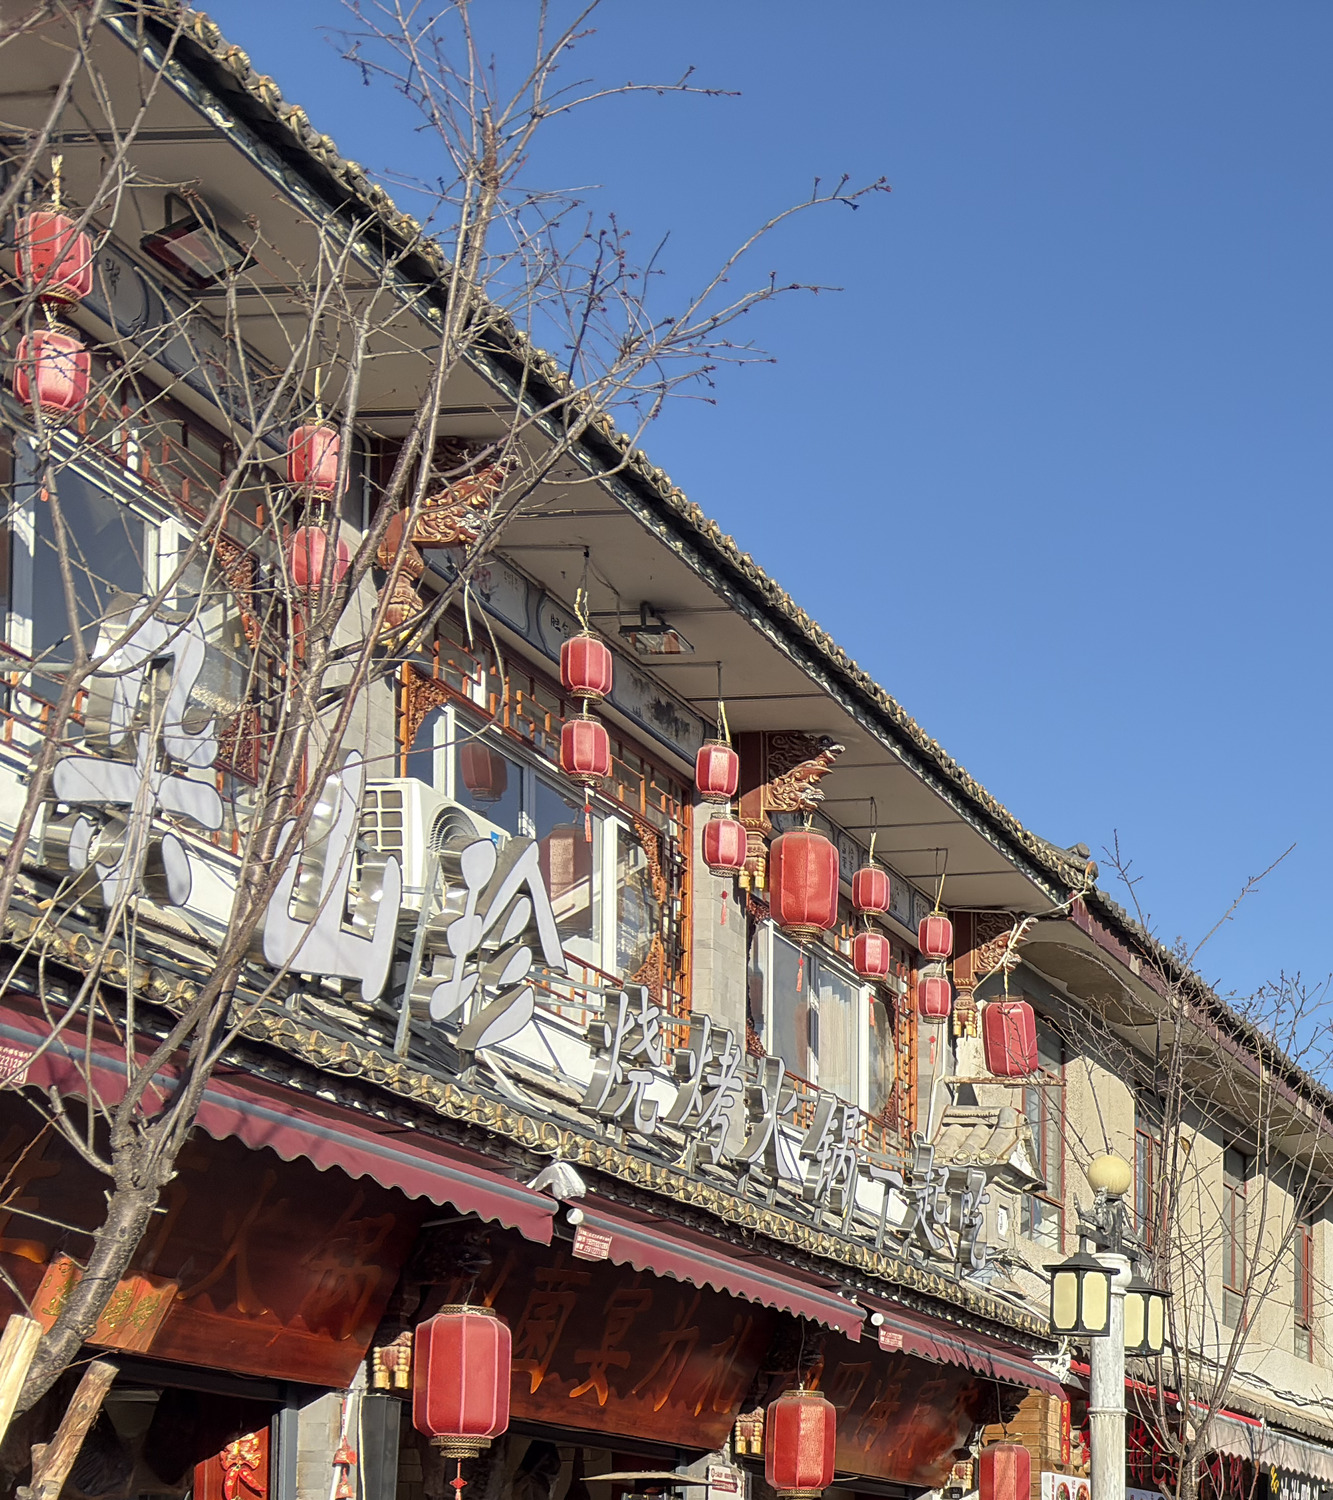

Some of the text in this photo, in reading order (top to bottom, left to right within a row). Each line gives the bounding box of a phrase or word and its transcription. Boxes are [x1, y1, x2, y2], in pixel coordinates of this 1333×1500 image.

[597, 988, 990, 1269] 烧烤火锅一起吃
